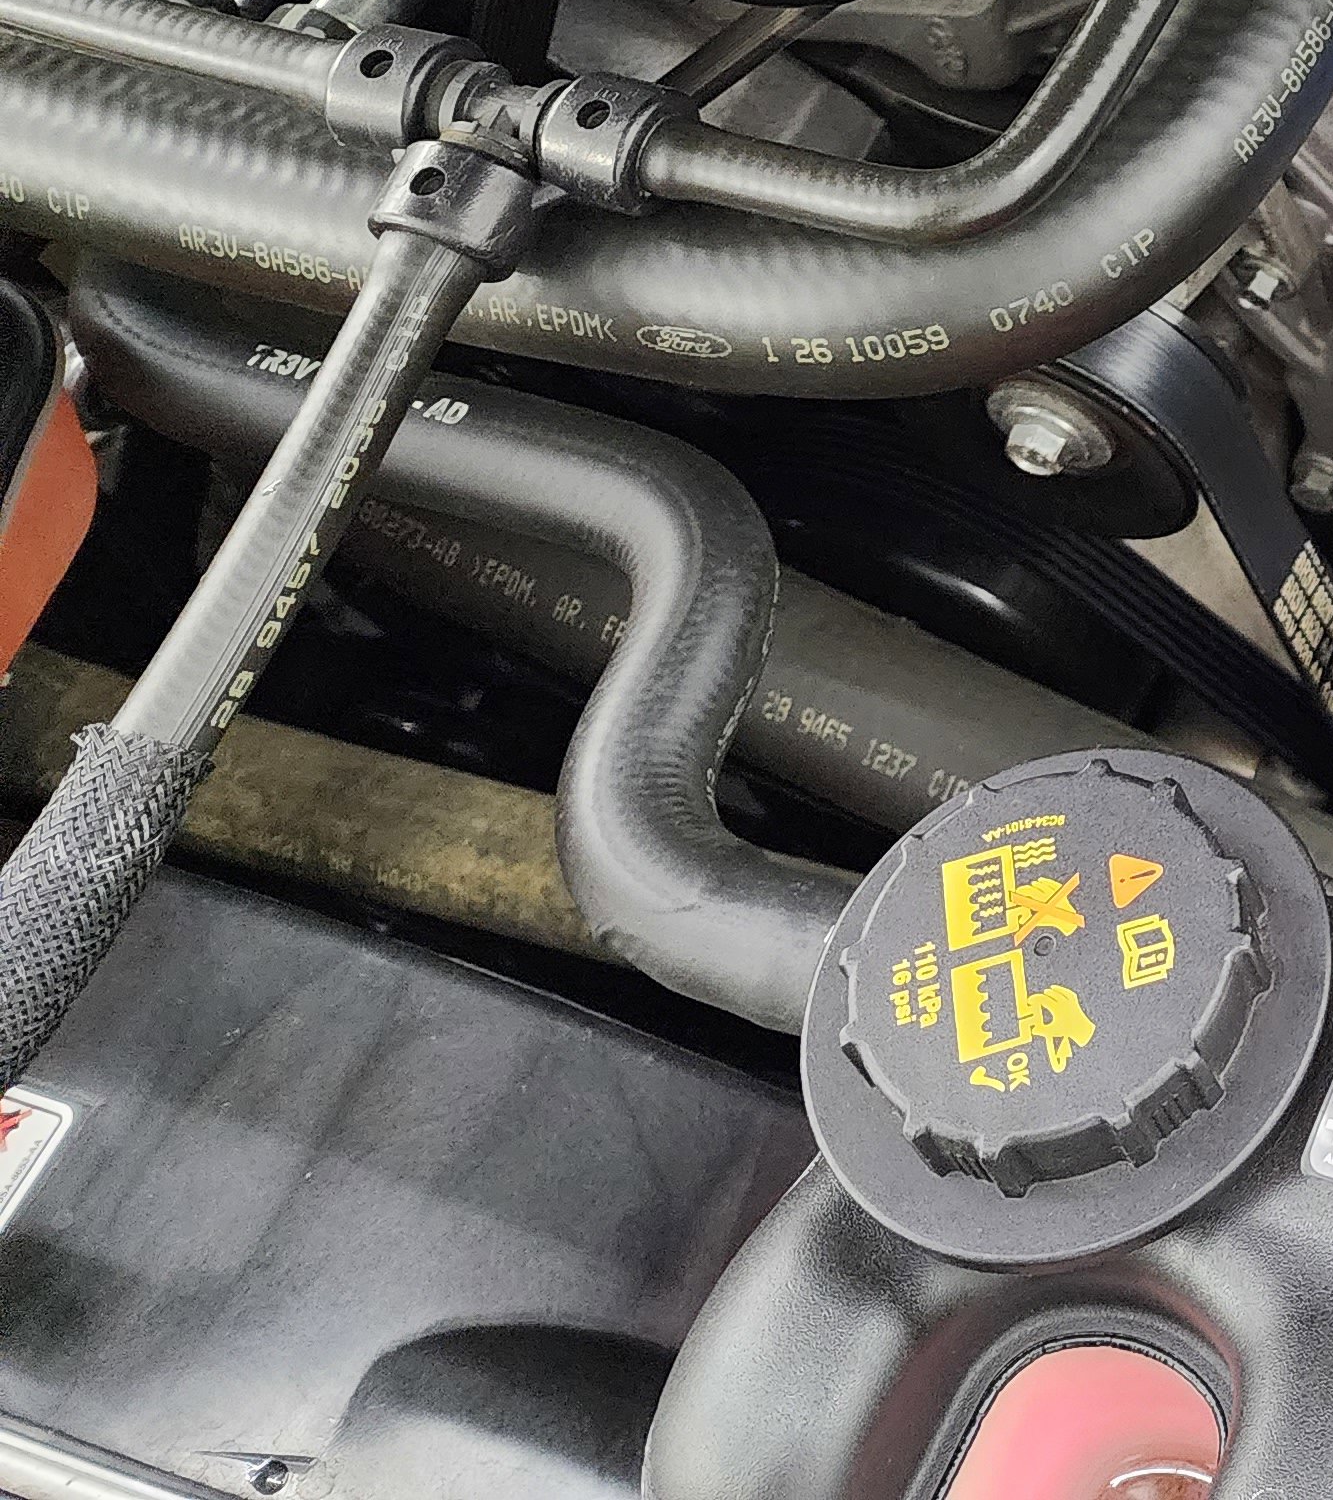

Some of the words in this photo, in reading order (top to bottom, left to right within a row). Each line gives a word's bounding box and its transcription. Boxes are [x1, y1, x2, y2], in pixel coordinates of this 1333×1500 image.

[648, 326, 720, 355] Ford
[796, 337, 833, 365] 26
[848, 323, 950, 364] 10059
[988, 281, 1075, 334] 0740
[1100, 227, 1157, 281] CIP
[891, 958, 912, 987] 16
[914, 941, 939, 982] 110
[890, 988, 918, 1027] psi
[918, 983, 943, 1029] kPa
[1006, 1052, 1033, 1092] OK
